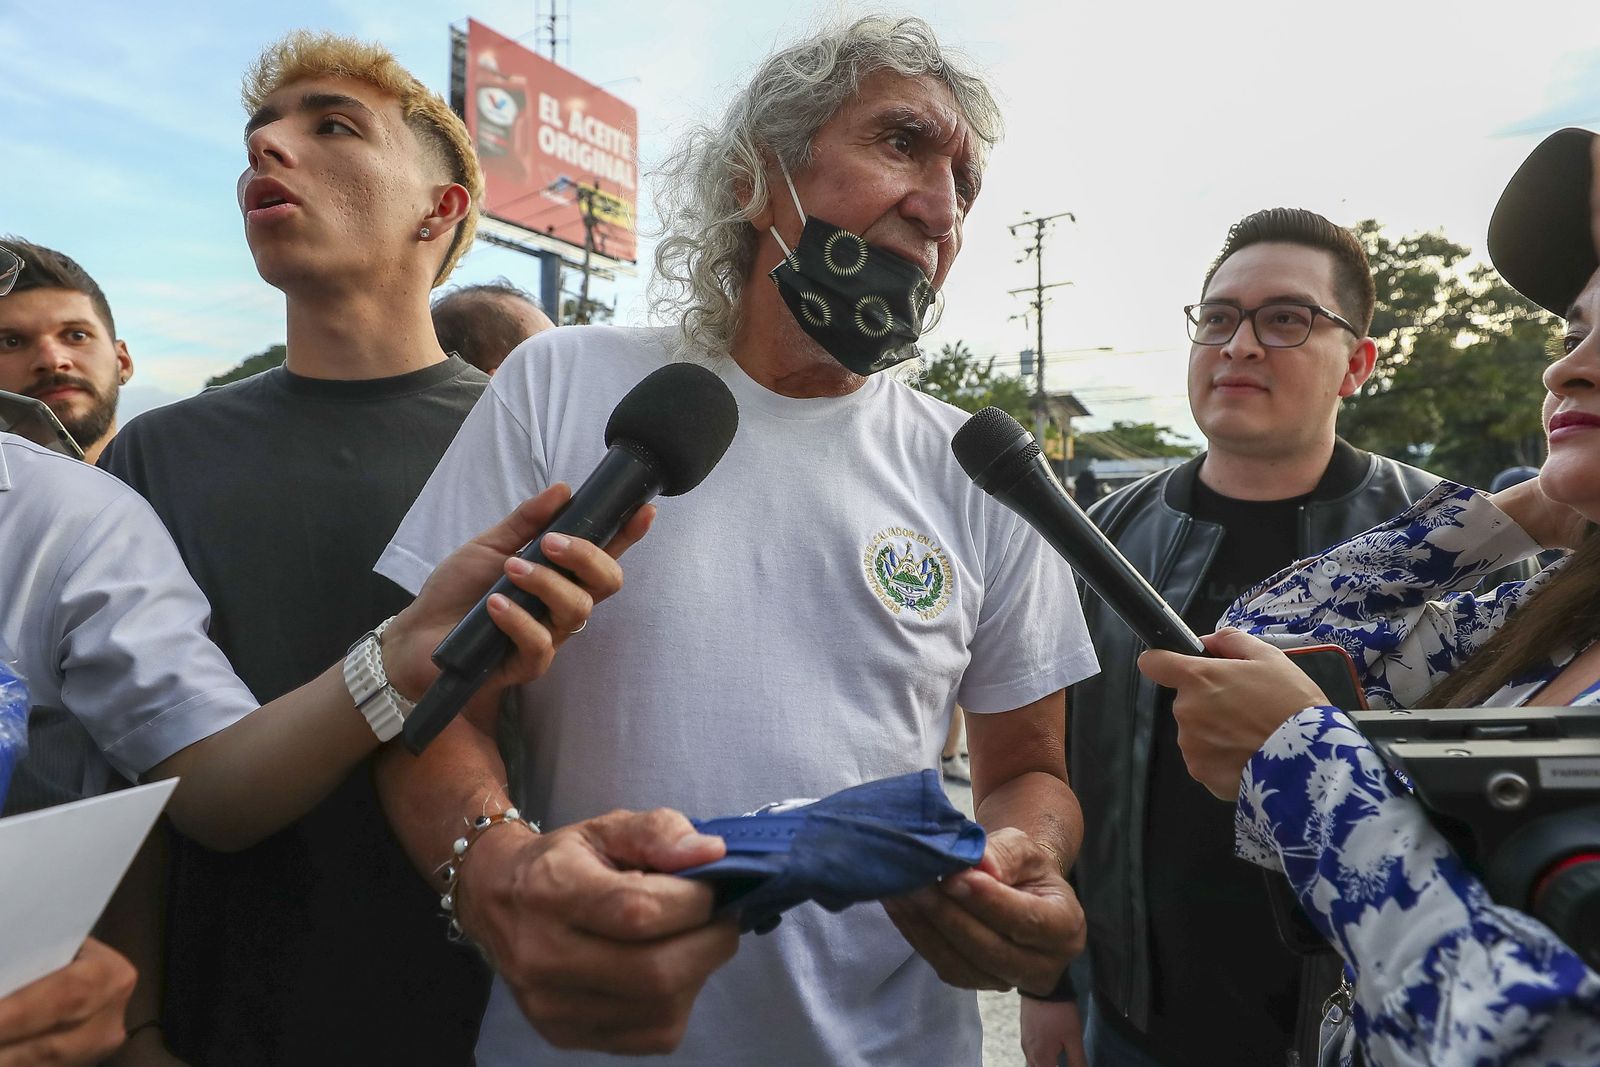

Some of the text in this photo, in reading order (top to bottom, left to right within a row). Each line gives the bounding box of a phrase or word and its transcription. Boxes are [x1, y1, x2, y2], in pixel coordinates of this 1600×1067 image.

[538, 124, 636, 191] ORIGINAL
[539, 92, 633, 161] EL ACEITE
